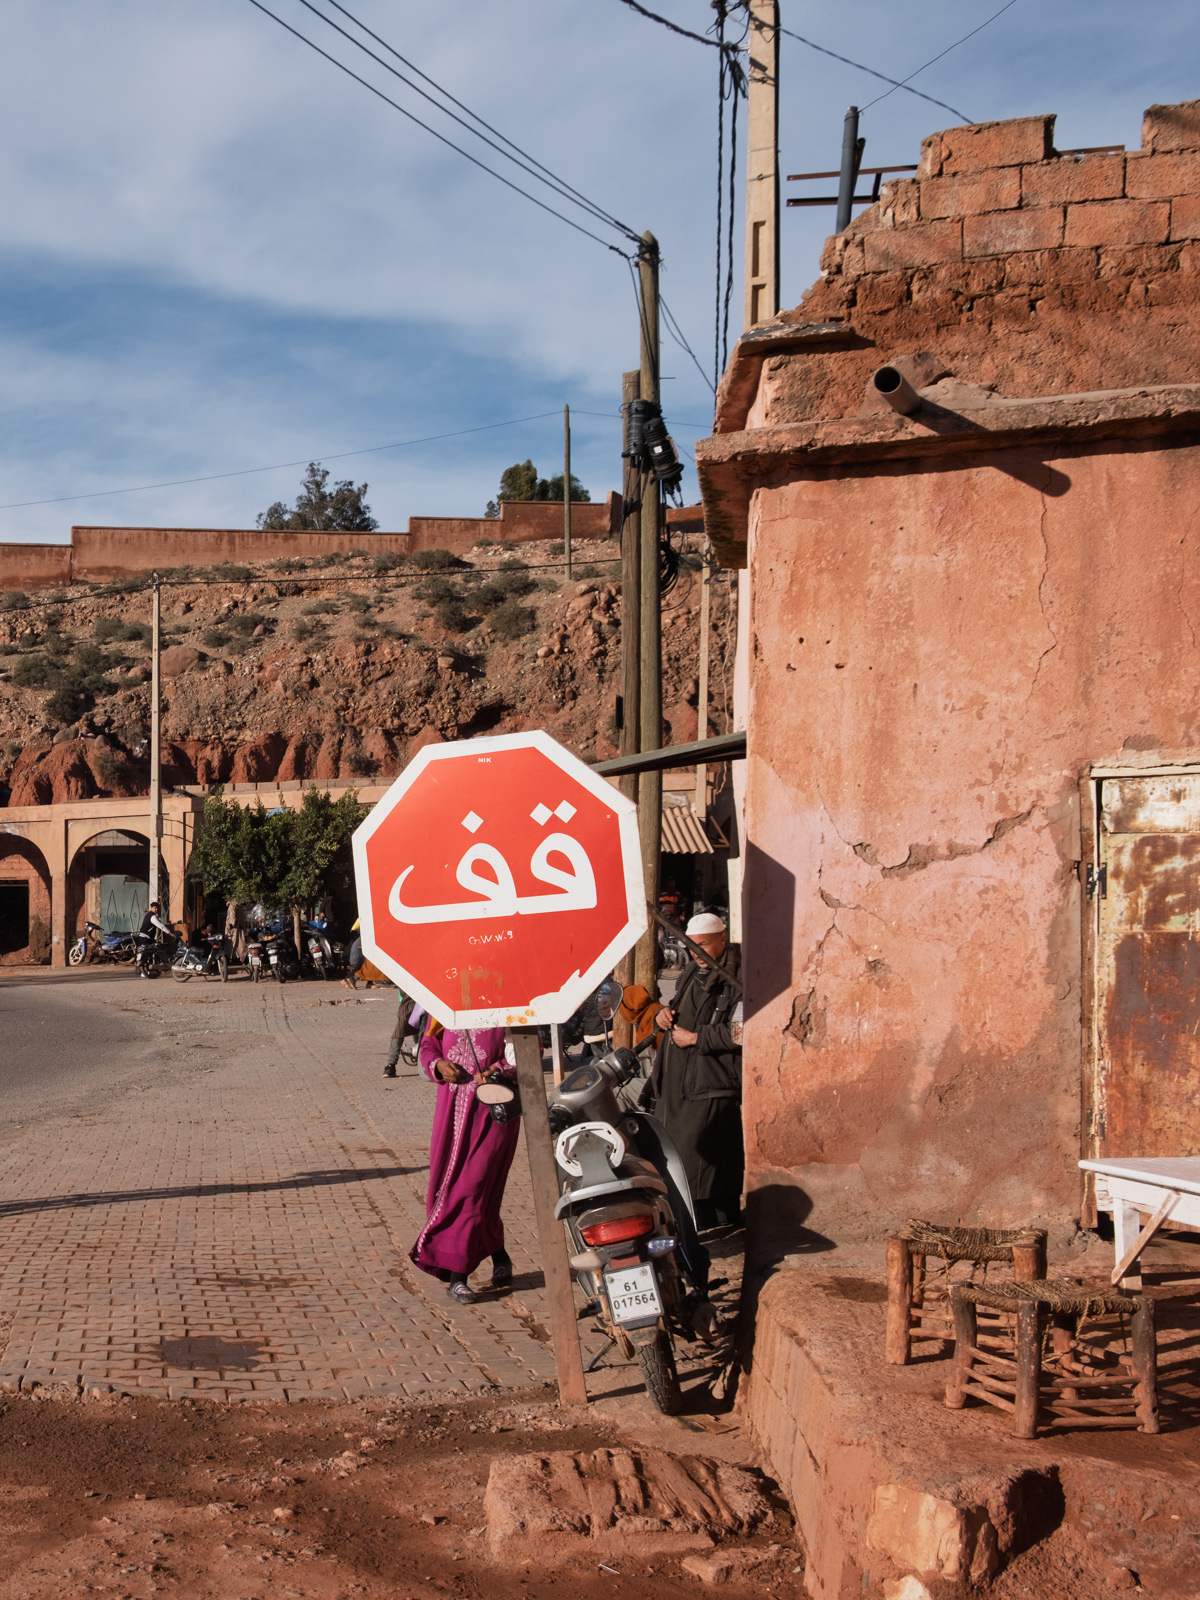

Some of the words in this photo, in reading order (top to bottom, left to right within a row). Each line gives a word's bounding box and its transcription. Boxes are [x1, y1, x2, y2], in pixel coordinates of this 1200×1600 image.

[388, 799, 597, 925] قف
[624, 1280, 638, 1292] 61
[613, 1292, 656, 1310] 017564
